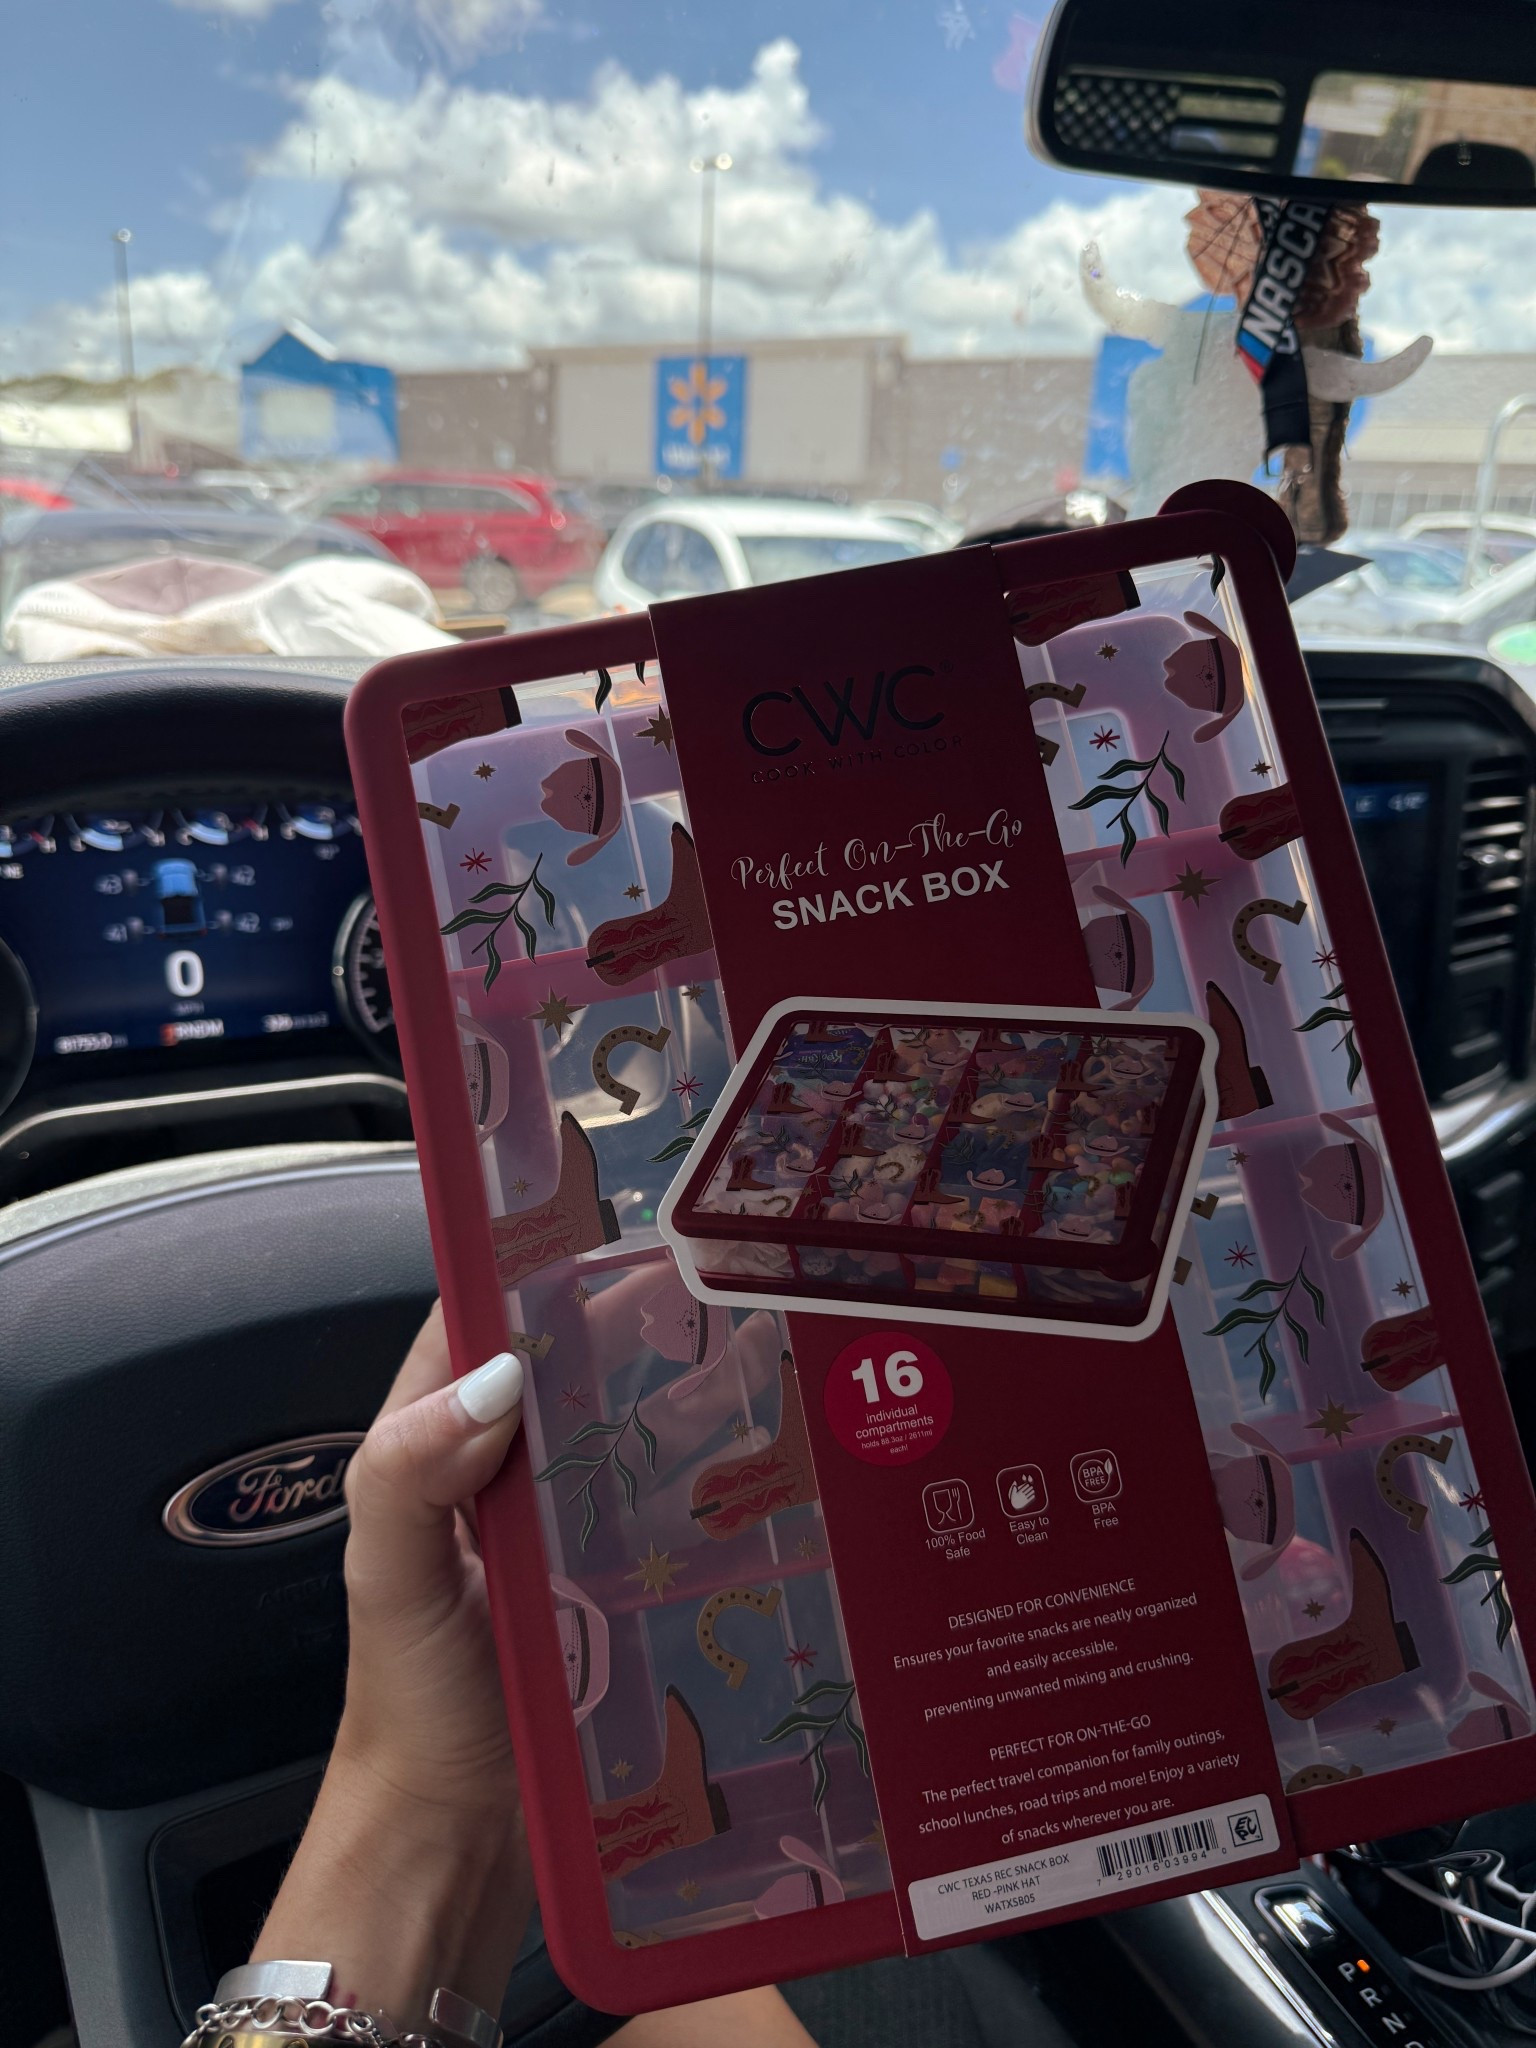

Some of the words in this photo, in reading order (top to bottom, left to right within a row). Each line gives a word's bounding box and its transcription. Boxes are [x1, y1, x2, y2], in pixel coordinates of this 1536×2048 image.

[1242, 199, 1328, 350] NASCA
[742, 664, 945, 756] CWC
[751, 760, 816, 784] COOK
[827, 748, 882, 770] WITH
[893, 735, 963, 758] COLOR
[730, 841, 829, 891] Perfect
[843, 808, 1023, 871] On-The-Go
[772, 877, 915, 930] SNACK
[922, 860, 1010, 903] BOX
[164, 949, 204, 997] 0
[851, 1350, 924, 1404] 16
[855, 1415, 934, 1439] compartments
[866, 1404, 918, 1424] individual
[861, 1440, 880, 1450] holds
[228, 1454, 347, 1523] Ford
[1082, 1466, 1104, 1478] BPA
[1084, 1476, 1106, 1487] FREE
[1009, 1520, 1036, 1533] Easy
[1039, 1516, 1049, 1526] to
[1091, 1502, 1116, 1515] BPA
[1093, 1515, 1119, 1529] Free
[925, 1535, 955, 1549] 100%
[957, 1528, 986, 1542] Food
[945, 1545, 971, 1560] Safe
[1016, 1530, 1048, 1545] Clean
[948, 1605, 1014, 1629] DESIGNED
[1016, 1598, 1043, 1615] FOR
[1045, 1578, 1136, 1608] CONVENIENCE
[893, 1650, 943, 1669] Ensures
[945, 1643, 974, 1660] your
[976, 1632, 1025, 1651] favorite
[1027, 1621, 1069, 1640] snacks
[1071, 1618, 1091, 1631] are
[1094, 1608, 1132, 1626] neatly
[1135, 1592, 1198, 1617] organized
[986, 1660, 1011, 1677] and
[1013, 1653, 1049, 1671] easily
[1051, 1639, 1118, 1663] accessible,
[924, 1695, 994, 1721] preventing
[996, 1678, 1061, 1703] unwanted
[1063, 1670, 1107, 1689] mixing
[1109, 1661, 1134, 1679] and
[1136, 1652, 1194, 1673] crushing.
[989, 1737, 1044, 1761] PERFECT
[1047, 1731, 1075, 1748] FOR
[1076, 1714, 1151, 1742] ON-THE-GO
[922, 1790, 947, 1804] The
[950, 1778, 997, 1802] perfect
[998, 1768, 1035, 1788] travel
[1037, 1754, 1110, 1779] companion
[1112, 1749, 1129, 1762] for
[1132, 1739, 1171, 1758] family
[1174, 1729, 1225, 1748] outings,
[918, 1812, 961, 1834] school
[963, 1804, 1017, 1824] lunches,
[1019, 1793, 1049, 1812] road
[1051, 1789, 1080, 1806] trips
[1083, 1780, 1107, 1799] and
[1110, 1771, 1147, 1792] more!
[1149, 1765, 1184, 1783] Enjoy
[1187, 1763, 1195, 1774] a
[1197, 1753, 1240, 1772] variety
[1001, 1828, 1015, 1844] of
[1017, 1821, 1060, 1841] snacks
[1062, 1808, 1121, 1831] wherever
[1124, 1802, 1149, 1819] you
[1151, 1797, 1175, 1811] are.
[937, 1881, 961, 1895] CWC
[963, 1872, 993, 1889] TEXAS
[995, 1867, 1013, 1881] REC
[1015, 1859, 1047, 1876] SNACK
[1049, 1853, 1070, 1867] BOX
[972, 1888, 991, 1901] RED
[1021, 1875, 1041, 1889] HAT
[984, 1893, 1036, 1914] WATXSB05
[1338, 1961, 1356, 1982] P
[1359, 1987, 1383, 2008] R
[1381, 2012, 1406, 2034] N
